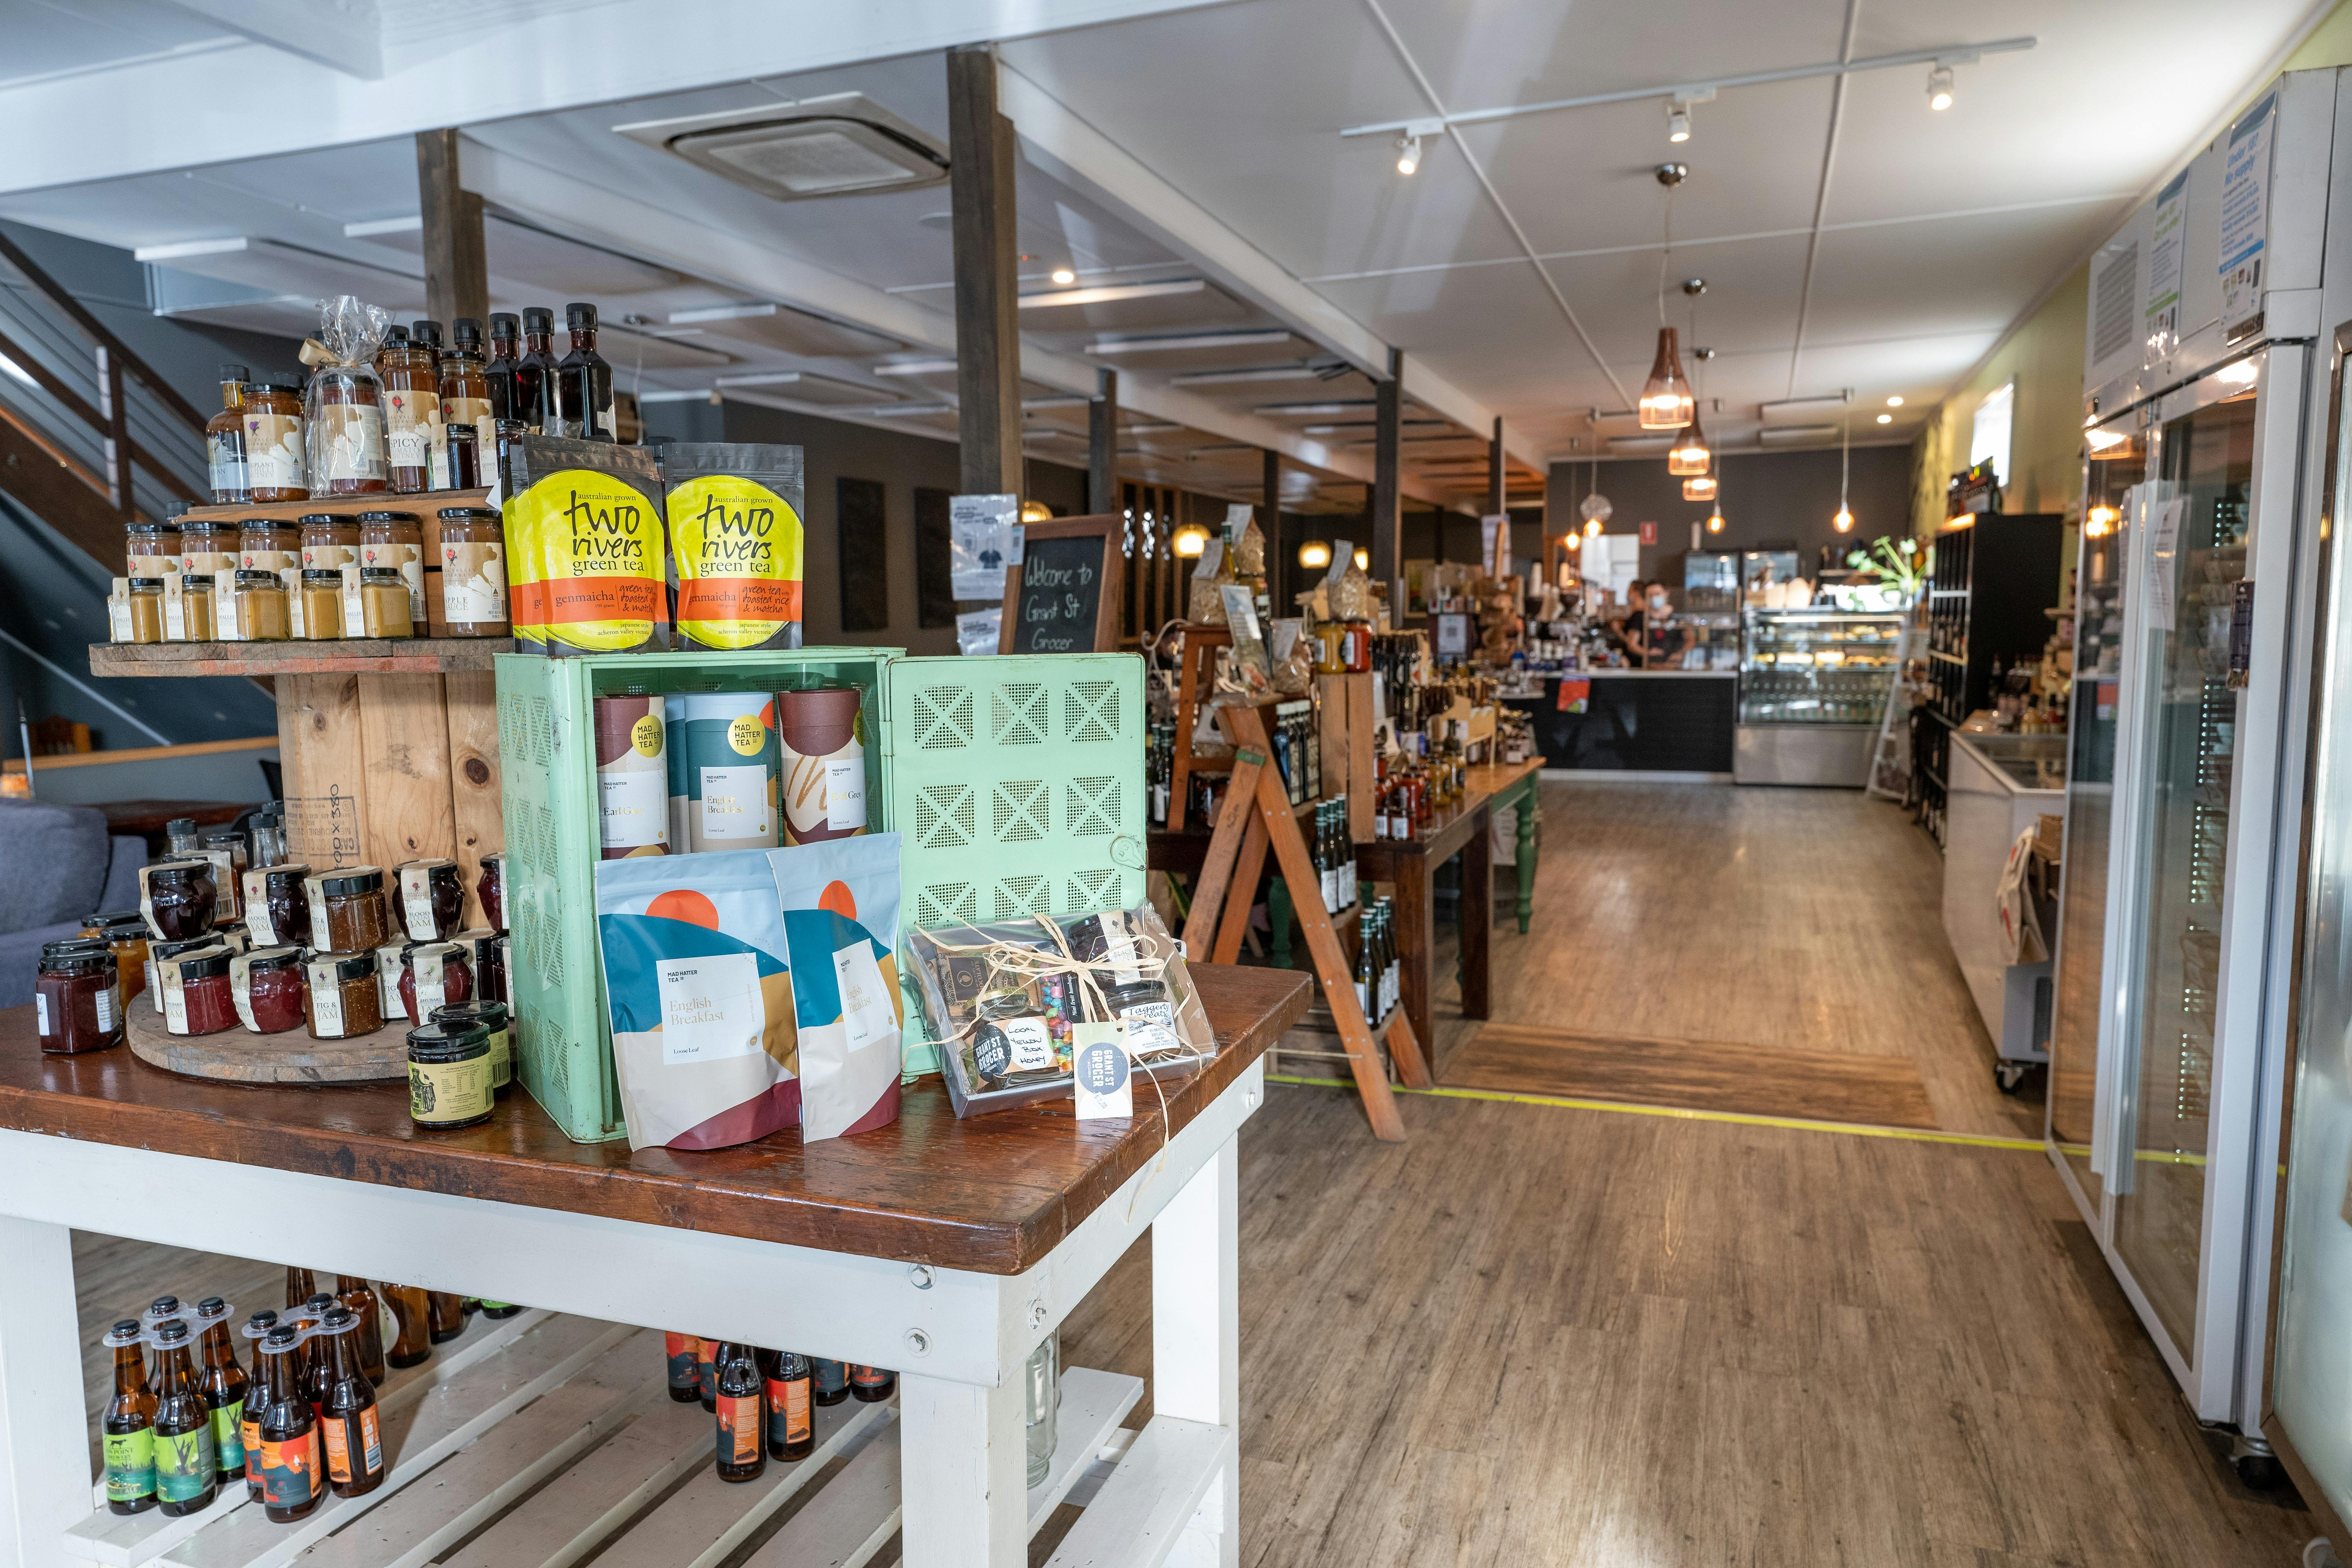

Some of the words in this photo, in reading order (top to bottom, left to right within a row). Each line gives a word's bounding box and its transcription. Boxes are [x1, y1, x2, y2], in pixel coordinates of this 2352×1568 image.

[390, 439, 419, 448] SPICY
[563, 490, 640, 536] two
[697, 494, 773, 539] two
[573, 532, 642, 558] rivers
[702, 534, 771, 560] rivers
[573, 560, 618, 576] green
[623, 560, 644, 571] tea
[701, 562, 743, 577] green
[750, 562, 771, 573] tea
[1024, 555, 1072, 588] Welcome
[1077, 563, 1093, 586] to
[619, 584, 642, 595] green
[644, 584, 653, 594] tea
[742, 586, 766, 596] green
[768, 586, 782, 595] tea
[556, 591, 614, 607] genmaicha
[621, 594, 648, 603] roasted
[689, 591, 736, 605] genmaicha
[743, 595, 772, 603] roasted
[753, 604, 783, 613] matcha
[1025, 595, 1058, 623] Grant
[1064, 593, 1080, 619] St
[1031, 627, 1074, 651] Grocer
[638, 731, 660, 740] HATTER
[707, 795, 736, 806] English
[832, 792, 847, 800] Earl
[848, 791, 861, 800] Grey
[604, 806, 621, 816] Earl
[708, 805, 744, 813] Breakfast
[314, 926, 326, 935] JAM
[410, 920, 431, 928] JAM
[1114, 948, 1132, 956] BLACK
[846, 984, 862, 1000] English
[420, 1006, 437, 1014] JA
[670, 997, 711, 1013] English
[849, 996, 872, 1013] Breakfast
[1128, 1004, 1169, 1015] Taggerty
[167, 1010, 183, 1018] JAM
[317, 1011, 338, 1021] JAM
[671, 1011, 724, 1025] Breakfast
[976, 1040, 991, 1058] GRANT
[978, 1047, 1005, 1071] GROCER
[1103, 1049, 1114, 1075] GRANT
[1092, 1050, 1104, 1087] GROCER
